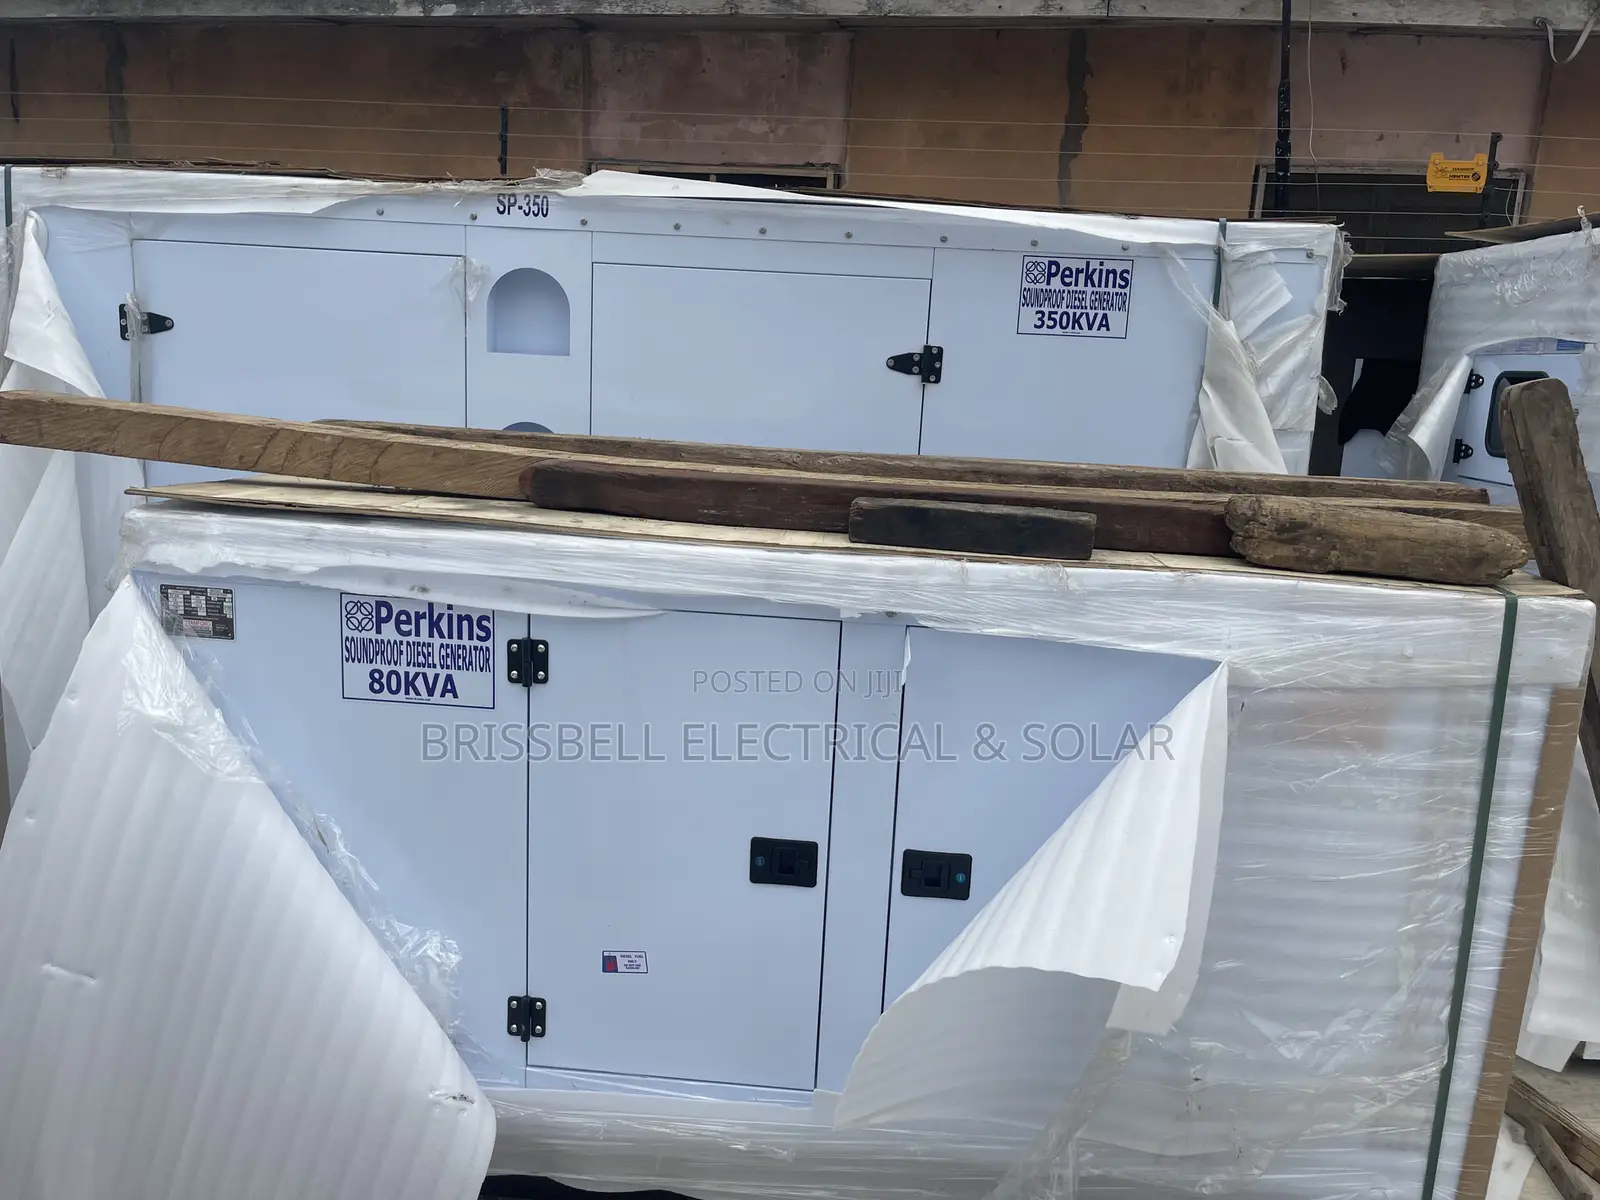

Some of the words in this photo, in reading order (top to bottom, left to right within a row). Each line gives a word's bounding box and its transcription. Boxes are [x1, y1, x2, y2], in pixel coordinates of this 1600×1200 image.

[496, 193, 549, 218] SP-350
[1046, 260, 1130, 290] Perkins
[1022, 287, 1066, 309] SOUNDPROOF
[1066, 289, 1088, 310] DIESEL
[1089, 290, 1128, 312] GENERATOR
[1034, 310, 1110, 331] 350KVA
[374, 600, 492, 643] Perkins
[344, 636, 404, 667] SOUNDPROOF
[406, 641, 437, 669] DIESEL
[439, 643, 492, 673] GENERATOR
[368, 668, 459, 699] 80KVA
